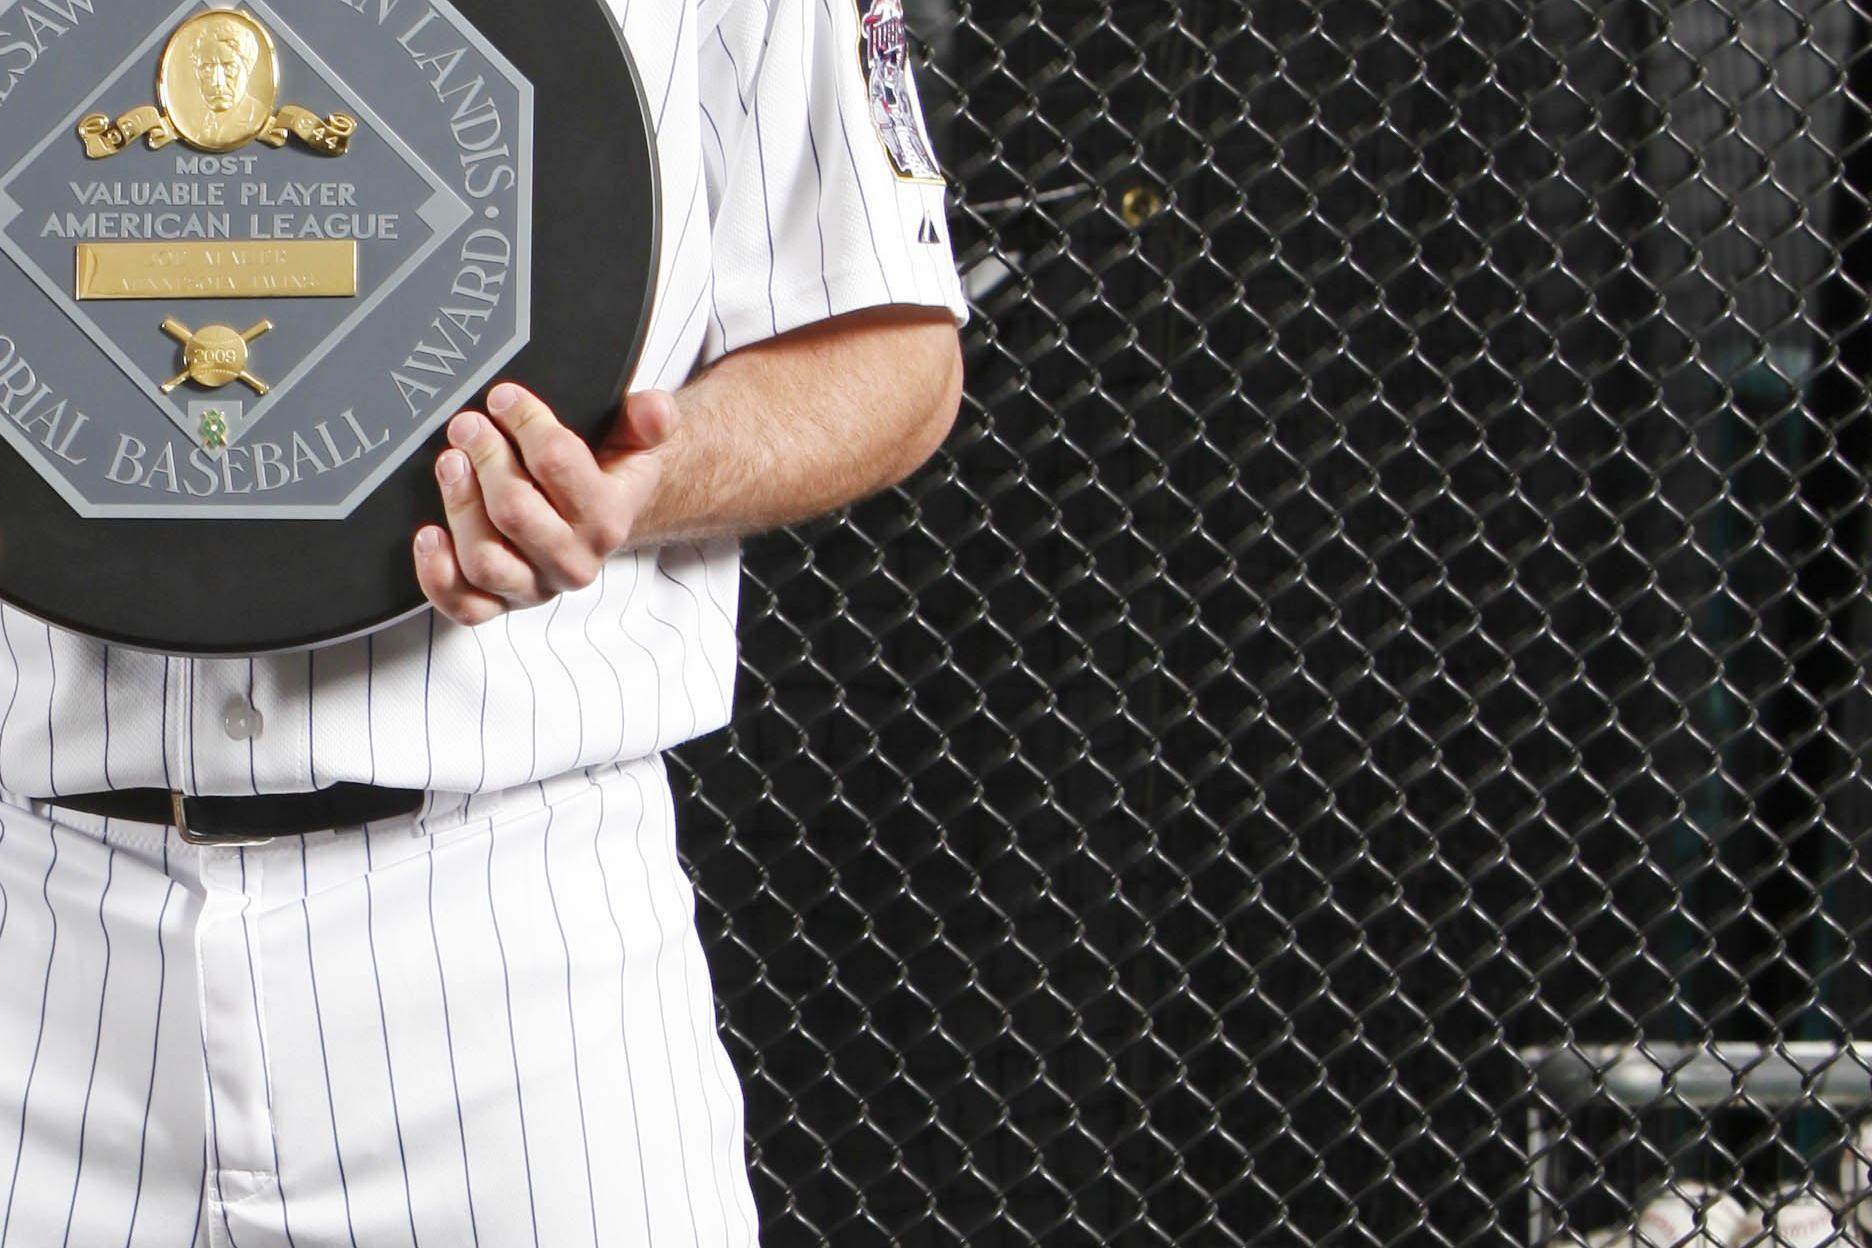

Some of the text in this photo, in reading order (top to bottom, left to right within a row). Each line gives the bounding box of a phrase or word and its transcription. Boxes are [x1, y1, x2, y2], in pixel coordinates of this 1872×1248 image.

[396, 7, 516, 199] LANDIS
[175, 155, 258, 176] MOST
[68, 181, 358, 207] VALUABLE PLAYER
[39, 211, 399, 240] AMERICAN LEAGUE
[103, 408, 390, 497] BASEBALL
[389, 228, 511, 419] AWARD
[193, 348, 237, 364] 2009
